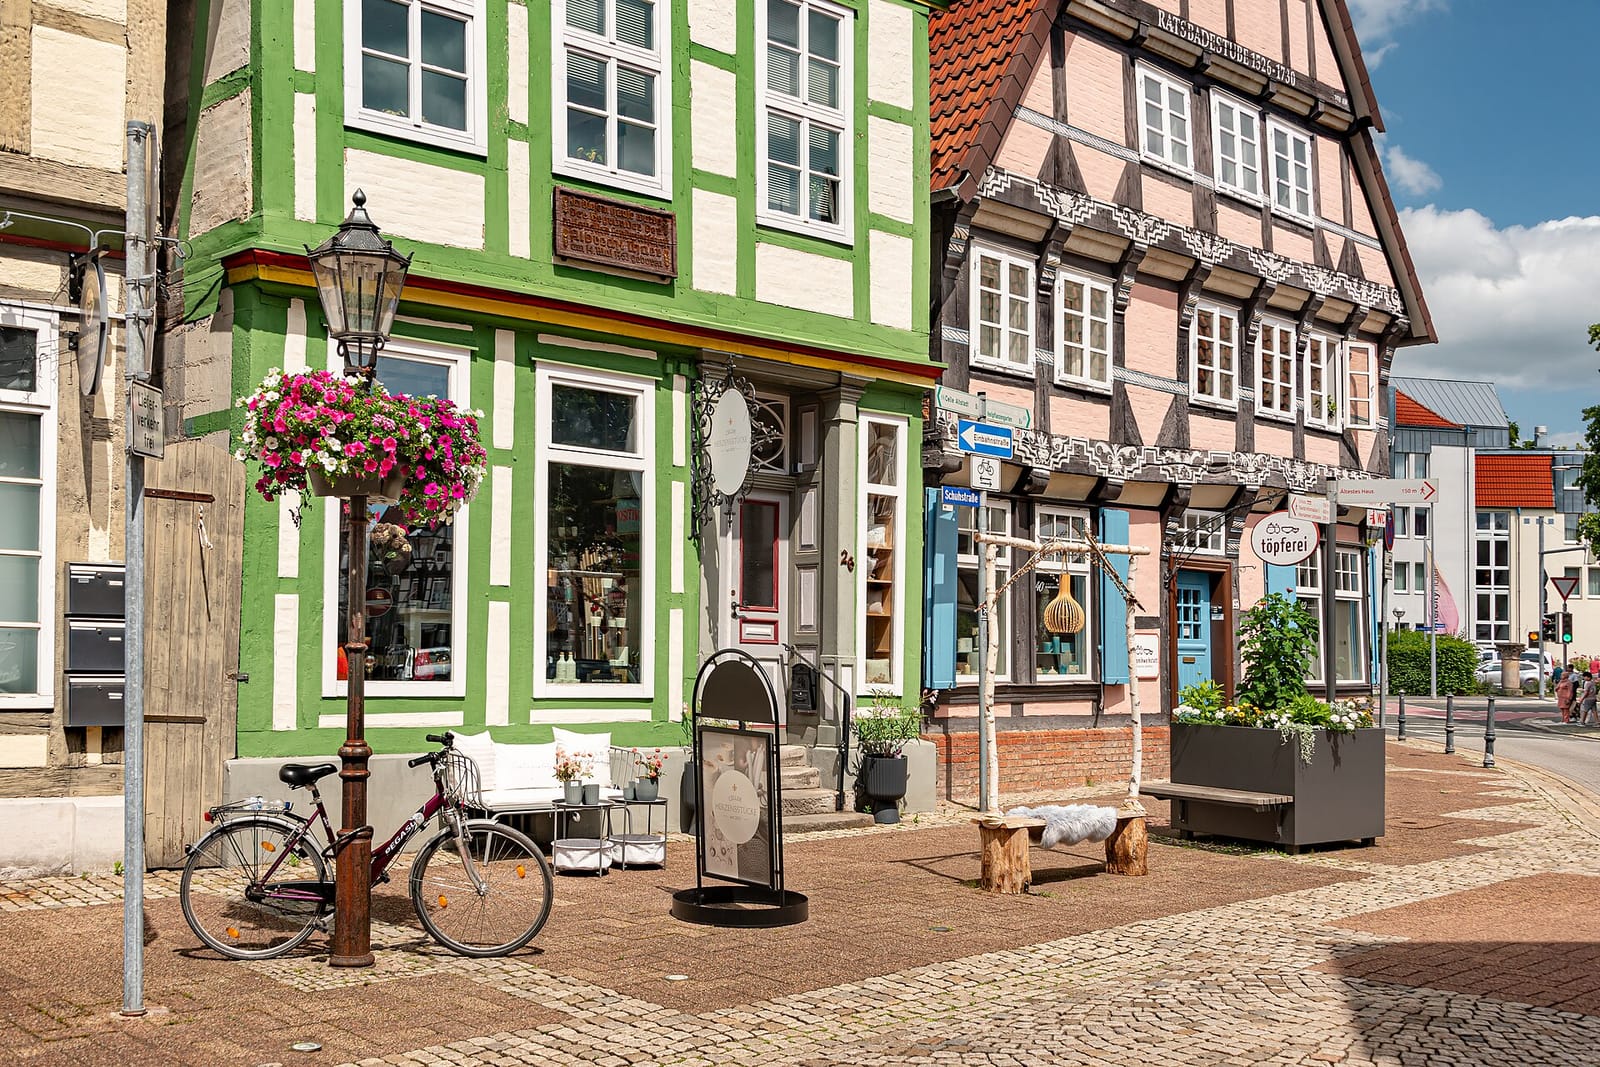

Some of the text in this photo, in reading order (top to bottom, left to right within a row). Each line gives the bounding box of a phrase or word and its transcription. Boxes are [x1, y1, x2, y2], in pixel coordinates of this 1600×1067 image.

[1158, 9, 1296, 87] RATSBADESTUBE 1526-1730
[137, 414, 160, 431] verkehr
[144, 433, 154, 449] frei
[974, 433, 1009, 447] Einbahnstraße
[944, 489, 978, 504] Schuhstraße
[1261, 536, 1308, 556] töpferei
[840, 549, 855, 573] 26
[385, 821, 417, 854] PEGASU
